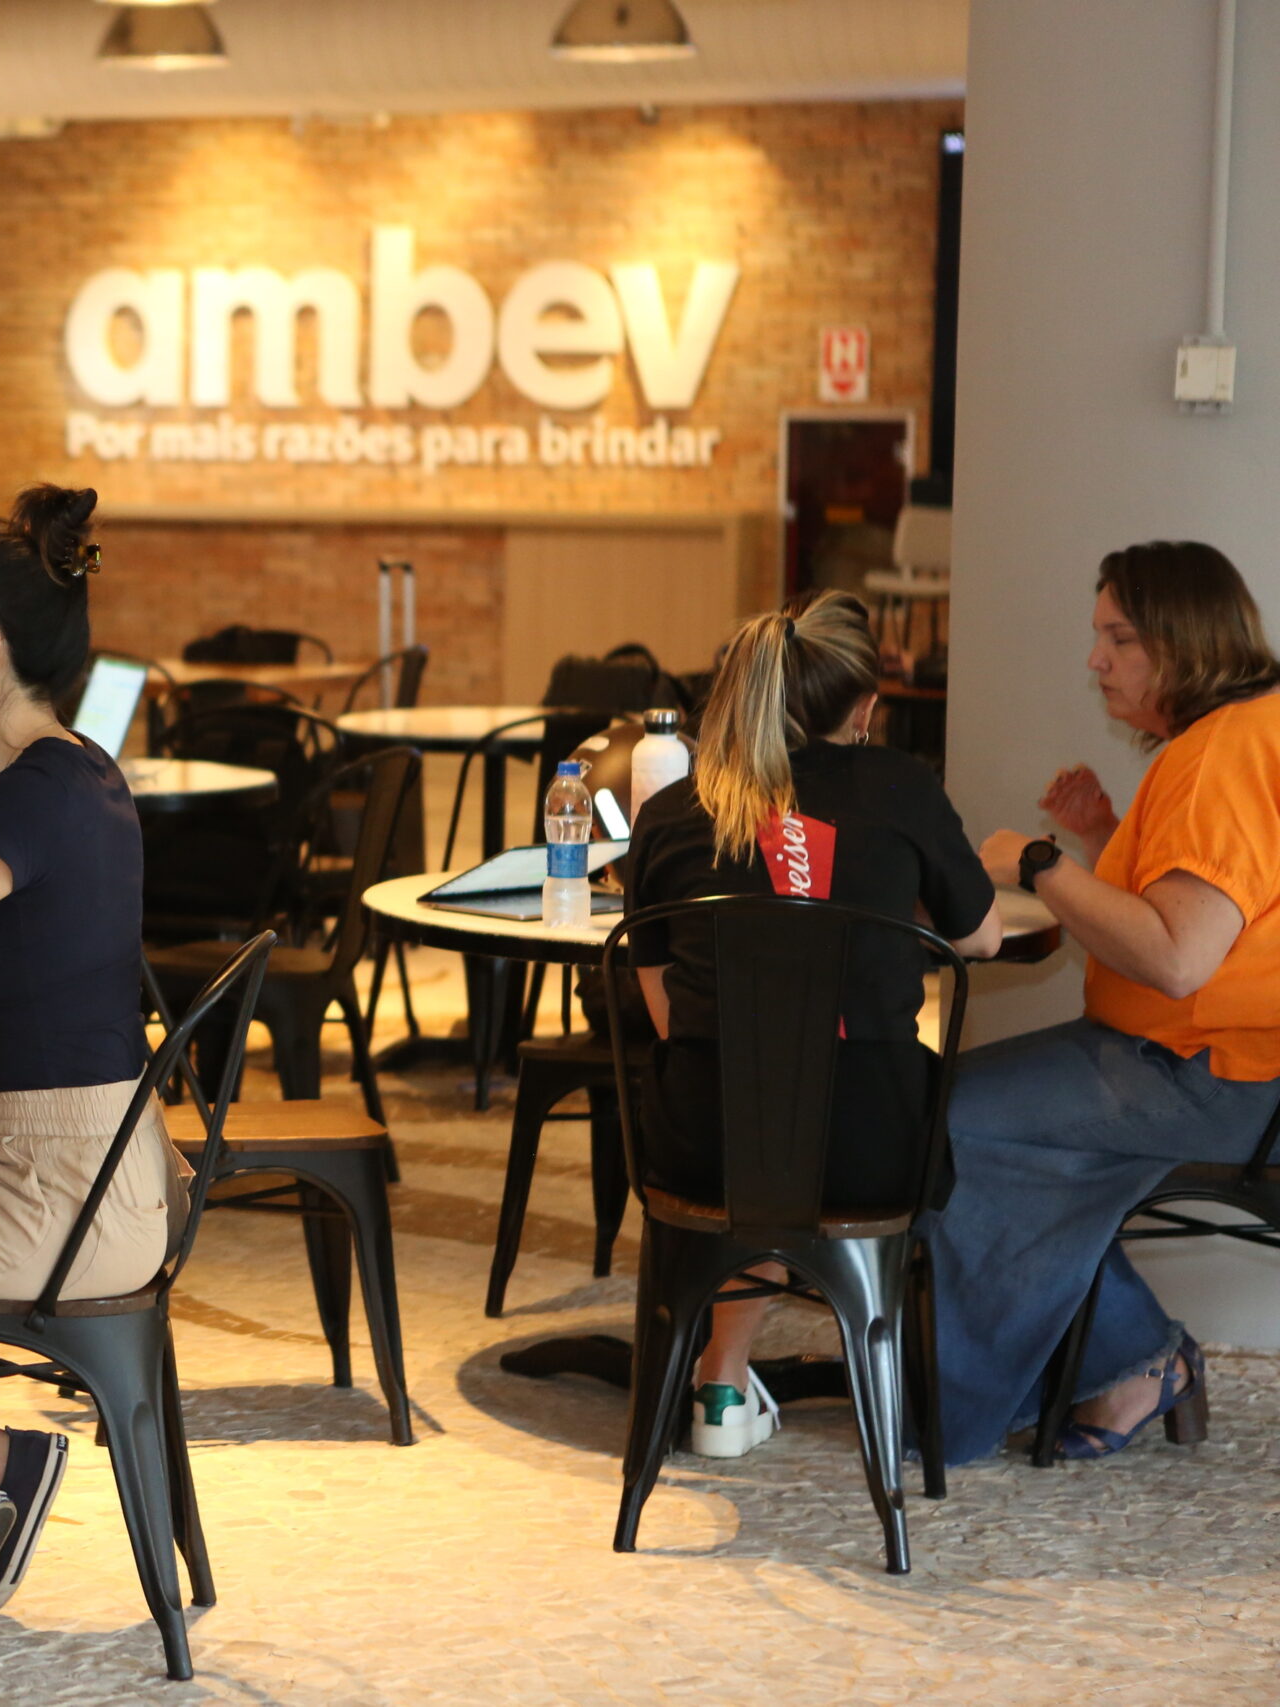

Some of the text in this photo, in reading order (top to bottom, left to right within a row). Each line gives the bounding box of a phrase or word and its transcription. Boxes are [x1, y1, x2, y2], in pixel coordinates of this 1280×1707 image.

[66, 226, 740, 410] ambev
[66, 411, 719, 474] Por mais razões para brindar
